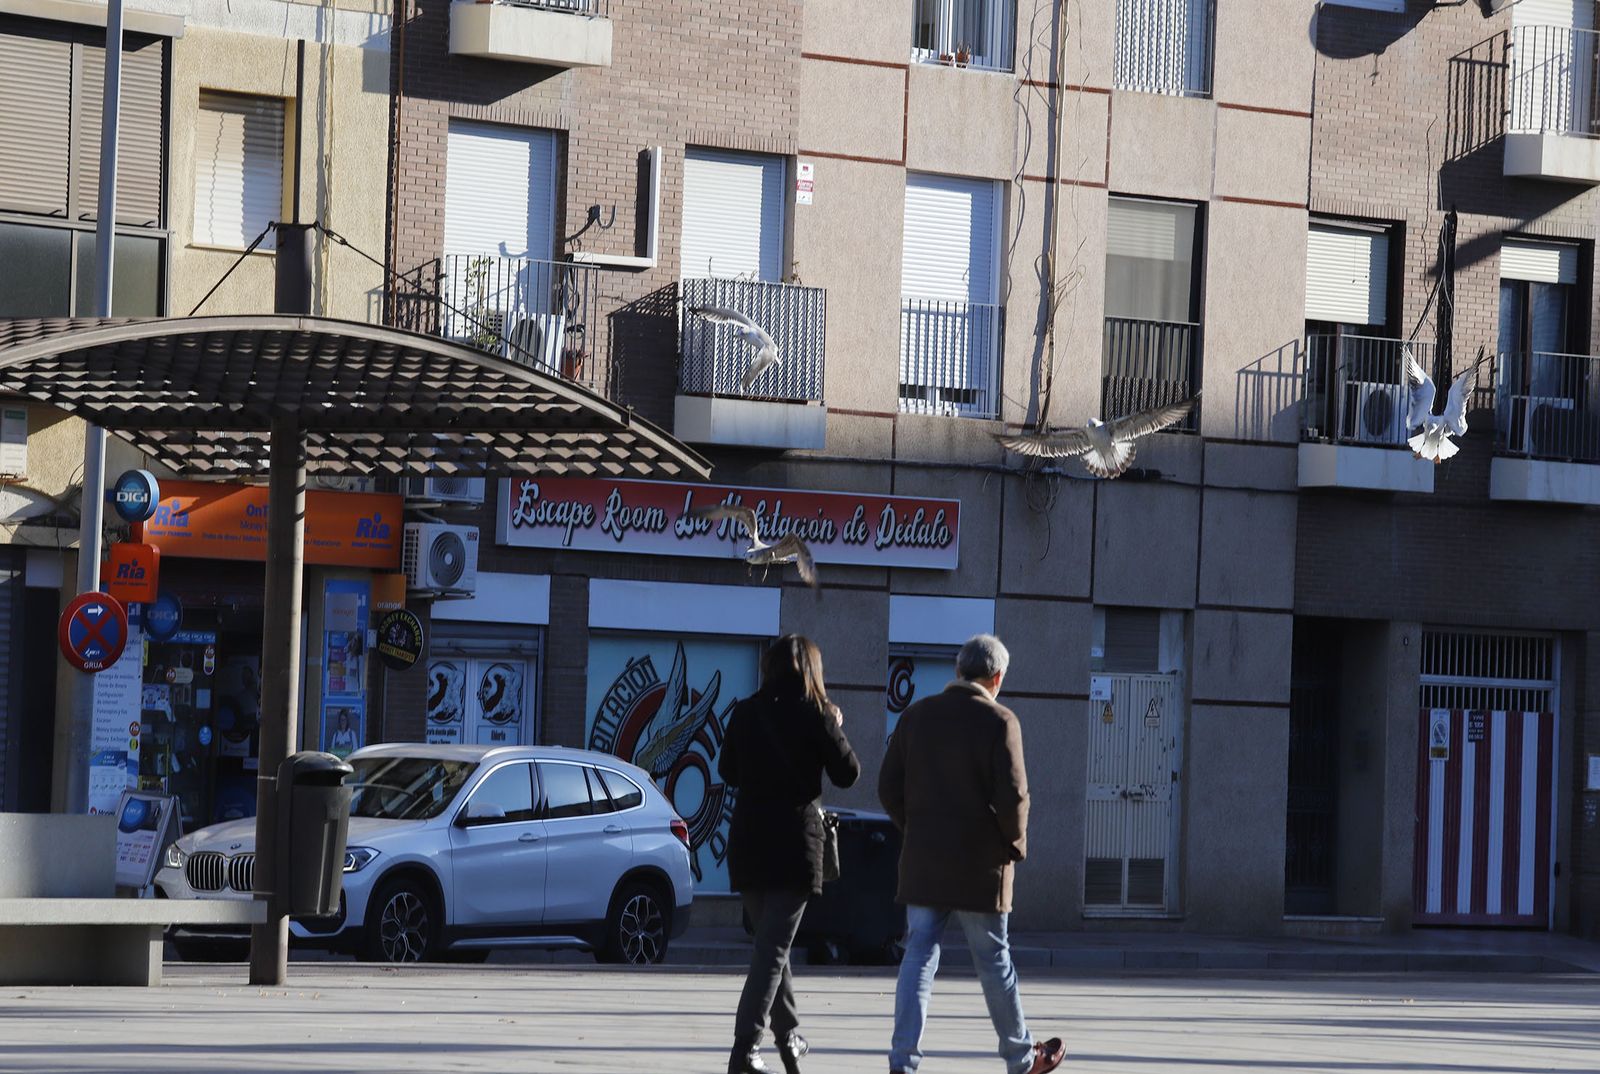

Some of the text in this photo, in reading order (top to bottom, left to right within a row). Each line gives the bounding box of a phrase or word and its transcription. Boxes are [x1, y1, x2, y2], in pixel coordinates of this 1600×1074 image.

[116, 491, 148, 503] DIGI
[154, 499, 188, 527] Ria
[512, 479, 595, 546] Escape
[601, 487, 667, 541] Room
[674, 490, 712, 538] La
[843, 504, 868, 543] de
[875, 503, 952, 550] Dédalo
[355, 512, 391, 539] Ria
[117, 559, 144, 579] Ria
[147, 610, 178, 620] DIGI
[377, 601, 401, 610] orange
[399, 612, 421, 647] EXCHANGE
